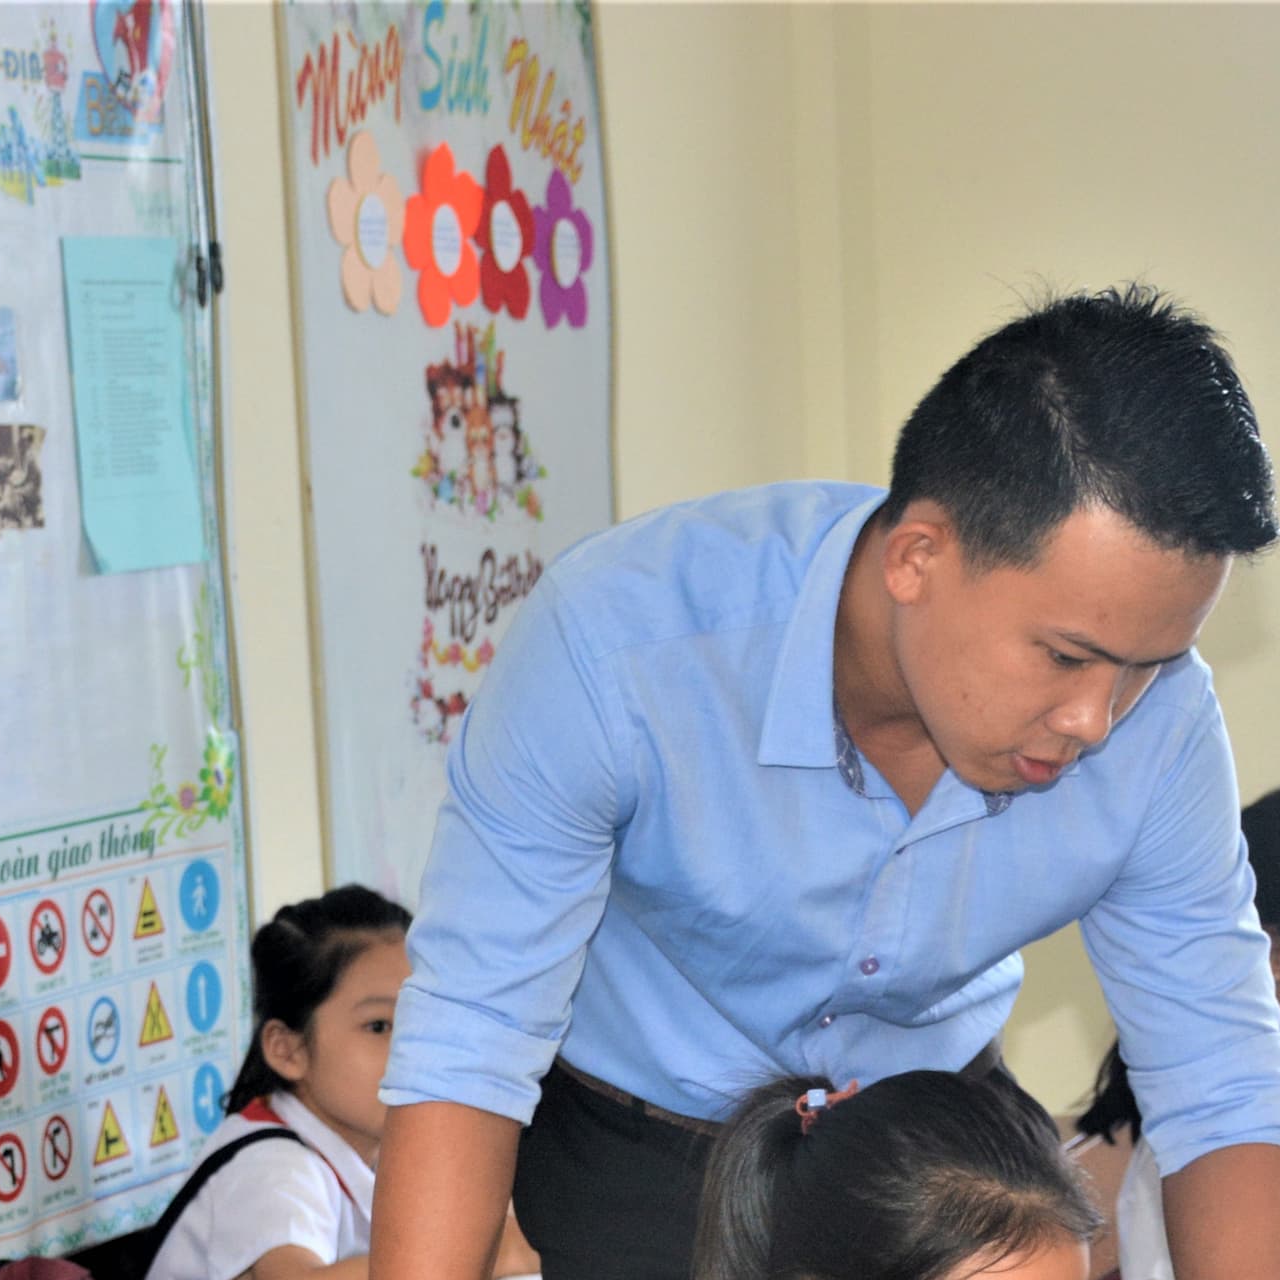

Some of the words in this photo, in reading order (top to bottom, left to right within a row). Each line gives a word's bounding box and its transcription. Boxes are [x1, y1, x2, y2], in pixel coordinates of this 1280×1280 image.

[420, 0, 490, 115] Sinh
[48, 836, 93, 881] giao
[100, 823, 156, 859] thông
